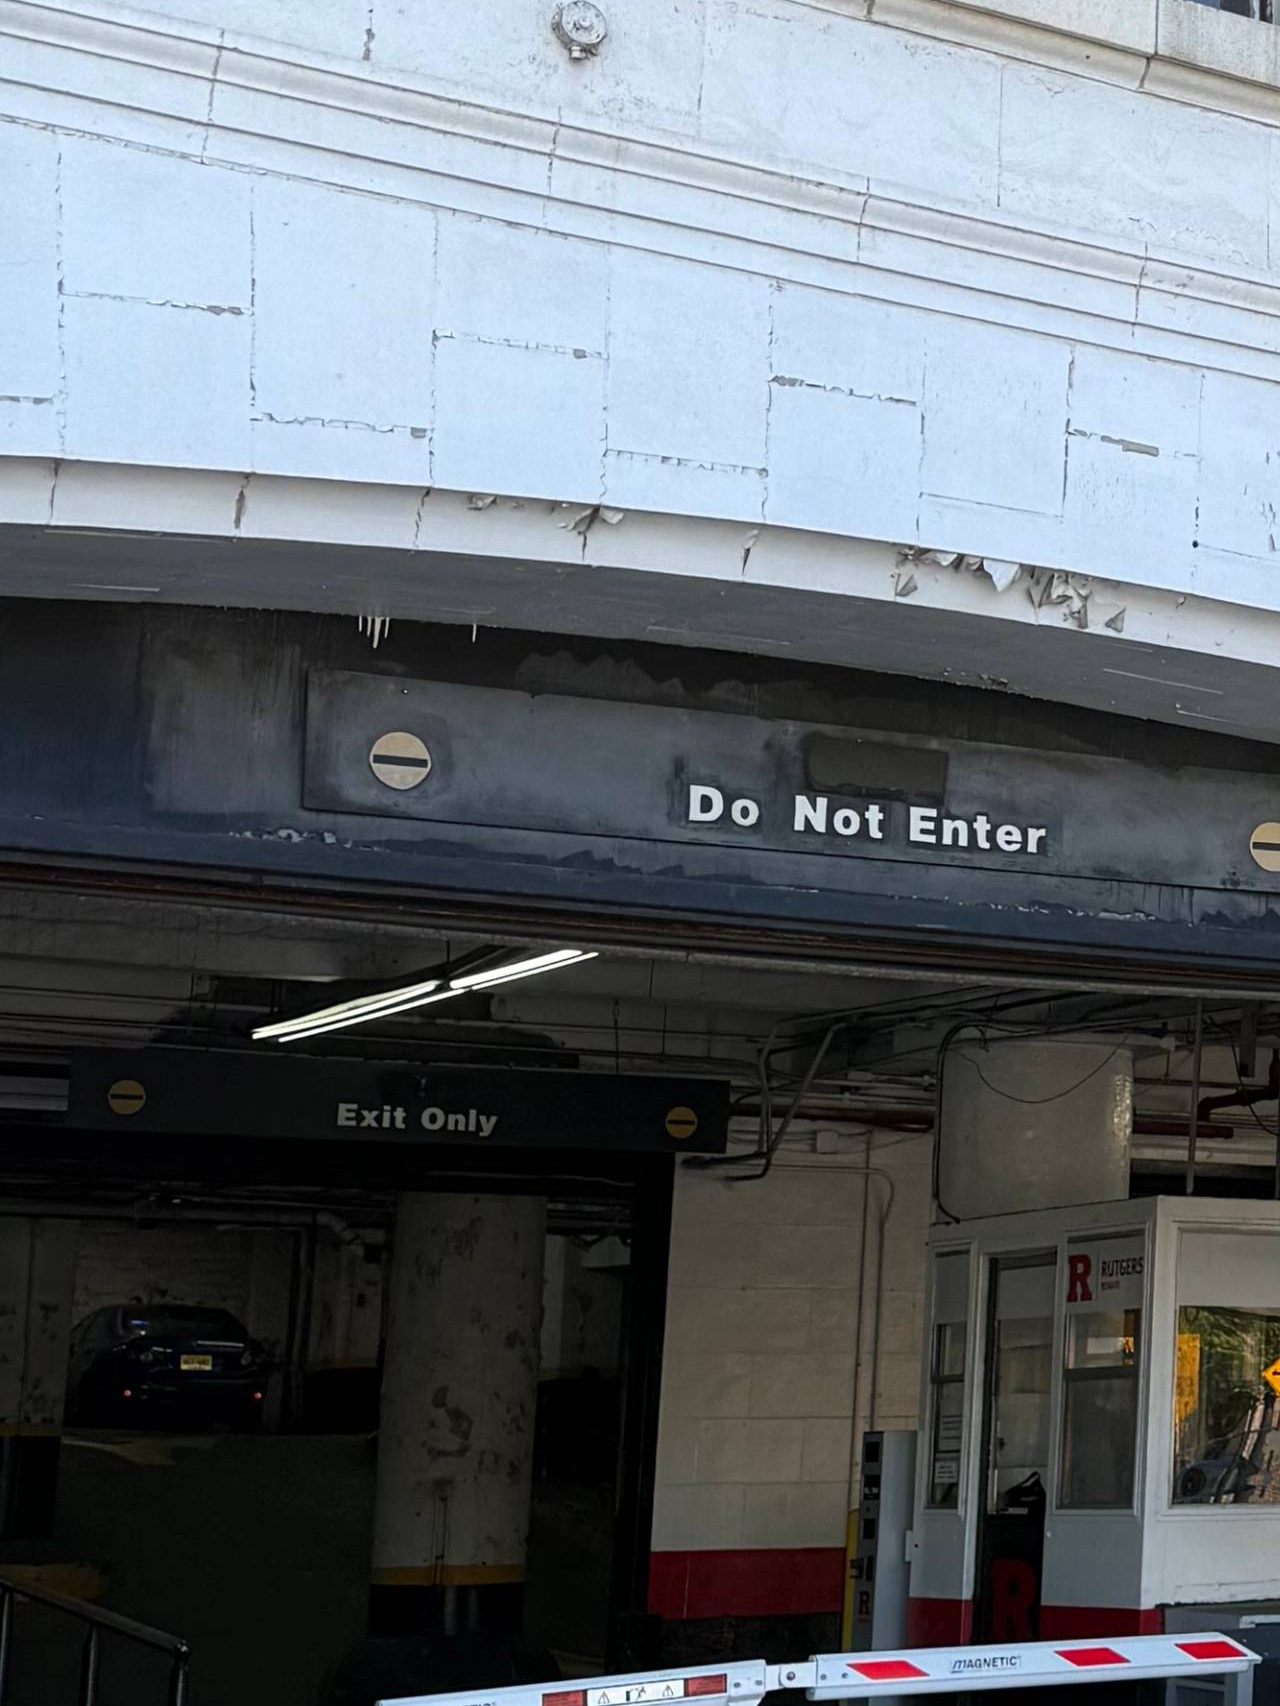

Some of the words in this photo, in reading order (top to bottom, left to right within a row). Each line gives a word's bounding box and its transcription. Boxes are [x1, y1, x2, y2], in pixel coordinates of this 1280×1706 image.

[688, 784, 759, 827] Do
[793, 795, 884, 840] Not
[909, 806, 1047, 854] Enter
[336, 1103, 406, 1129] Exit
[421, 1107, 498, 1137] Only
[1066, 1254, 1093, 1303] R
[1101, 1257, 1145, 1278] RUTGERS
